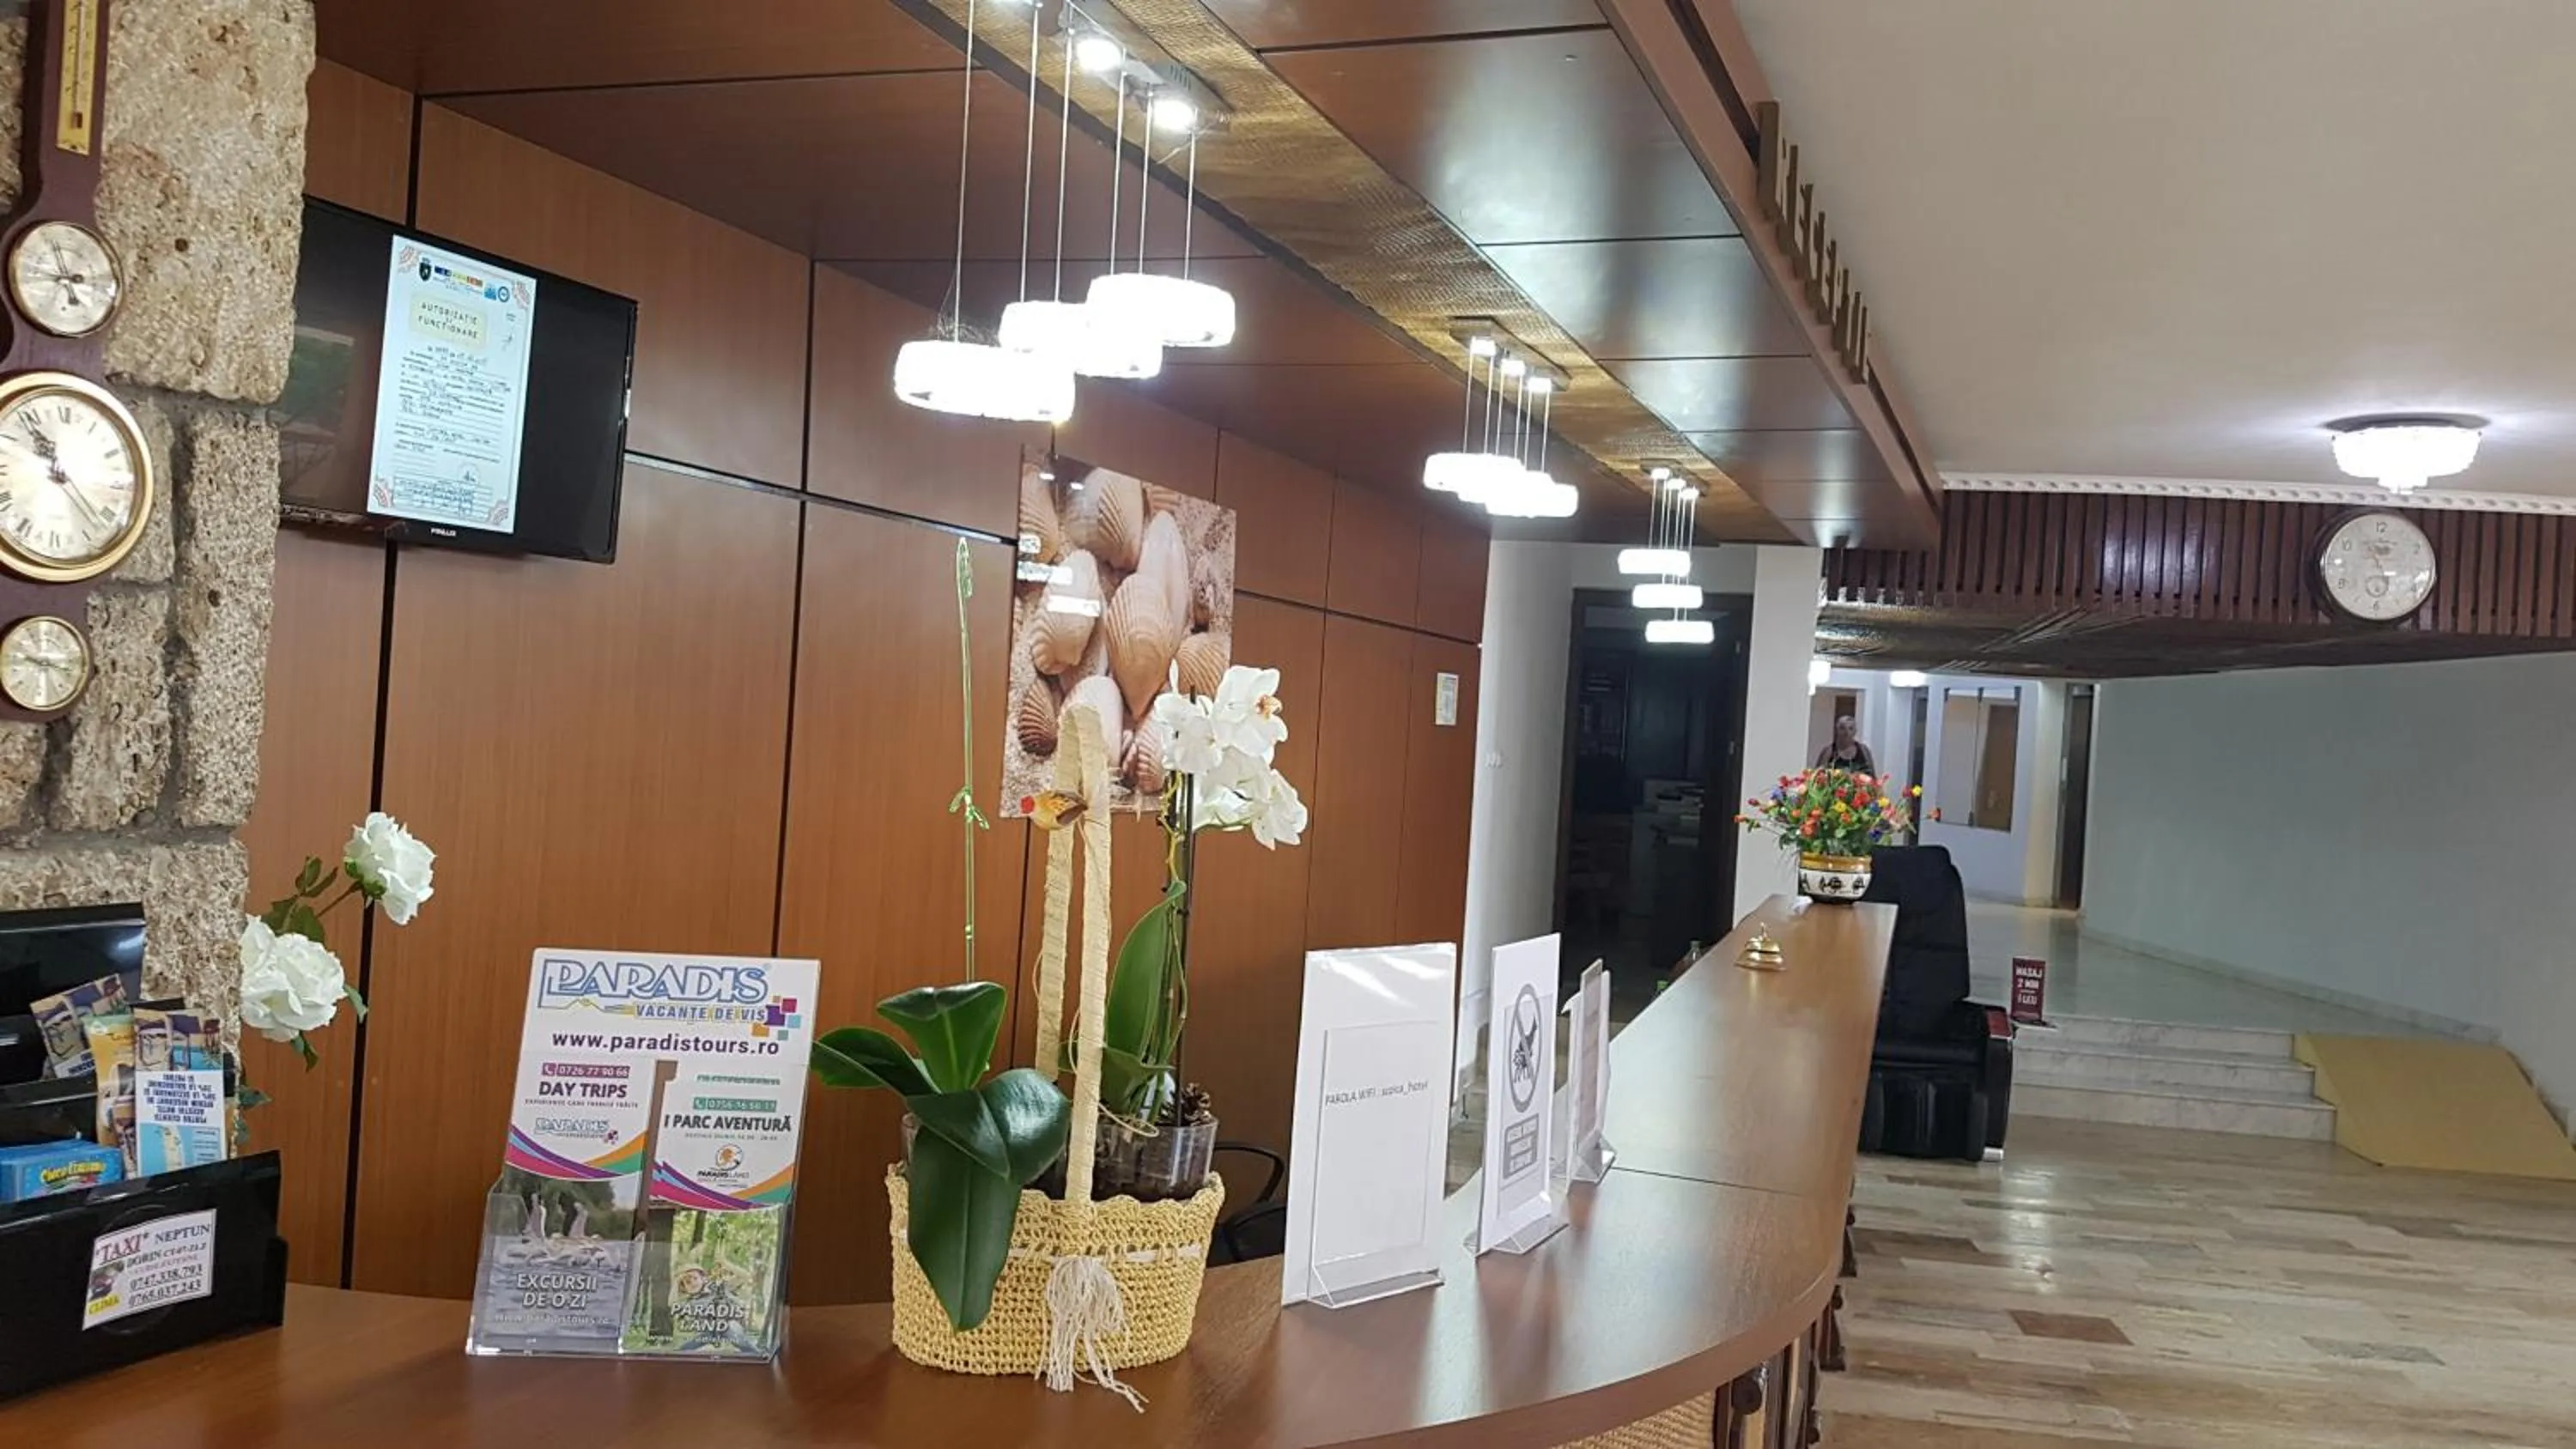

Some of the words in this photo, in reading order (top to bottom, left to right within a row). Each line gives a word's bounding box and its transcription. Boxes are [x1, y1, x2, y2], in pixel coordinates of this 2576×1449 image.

[538, 960, 769, 1006] PARADIS
[714, 1008, 736, 1021] DE
[741, 1009, 767, 1022] VIS
[552, 1032, 780, 1056] www.paradistours.ro
[538, 1081, 576, 1096] DAY
[580, 1082, 628, 1098] TRIPS
[672, 1114, 712, 1130] PARC
[713, 1115, 792, 1132] AVENTURĂ
[155, 1224, 211, 1246] NEPTUN
[517, 1273, 598, 1292] EXCURSII
[522, 1291, 548, 1308] DE
[551, 1292, 566, 1308] O
[569, 1294, 586, 1310] ZI
[671, 1302, 745, 1319] PARADIS
[679, 1319, 729, 1332] LAND
